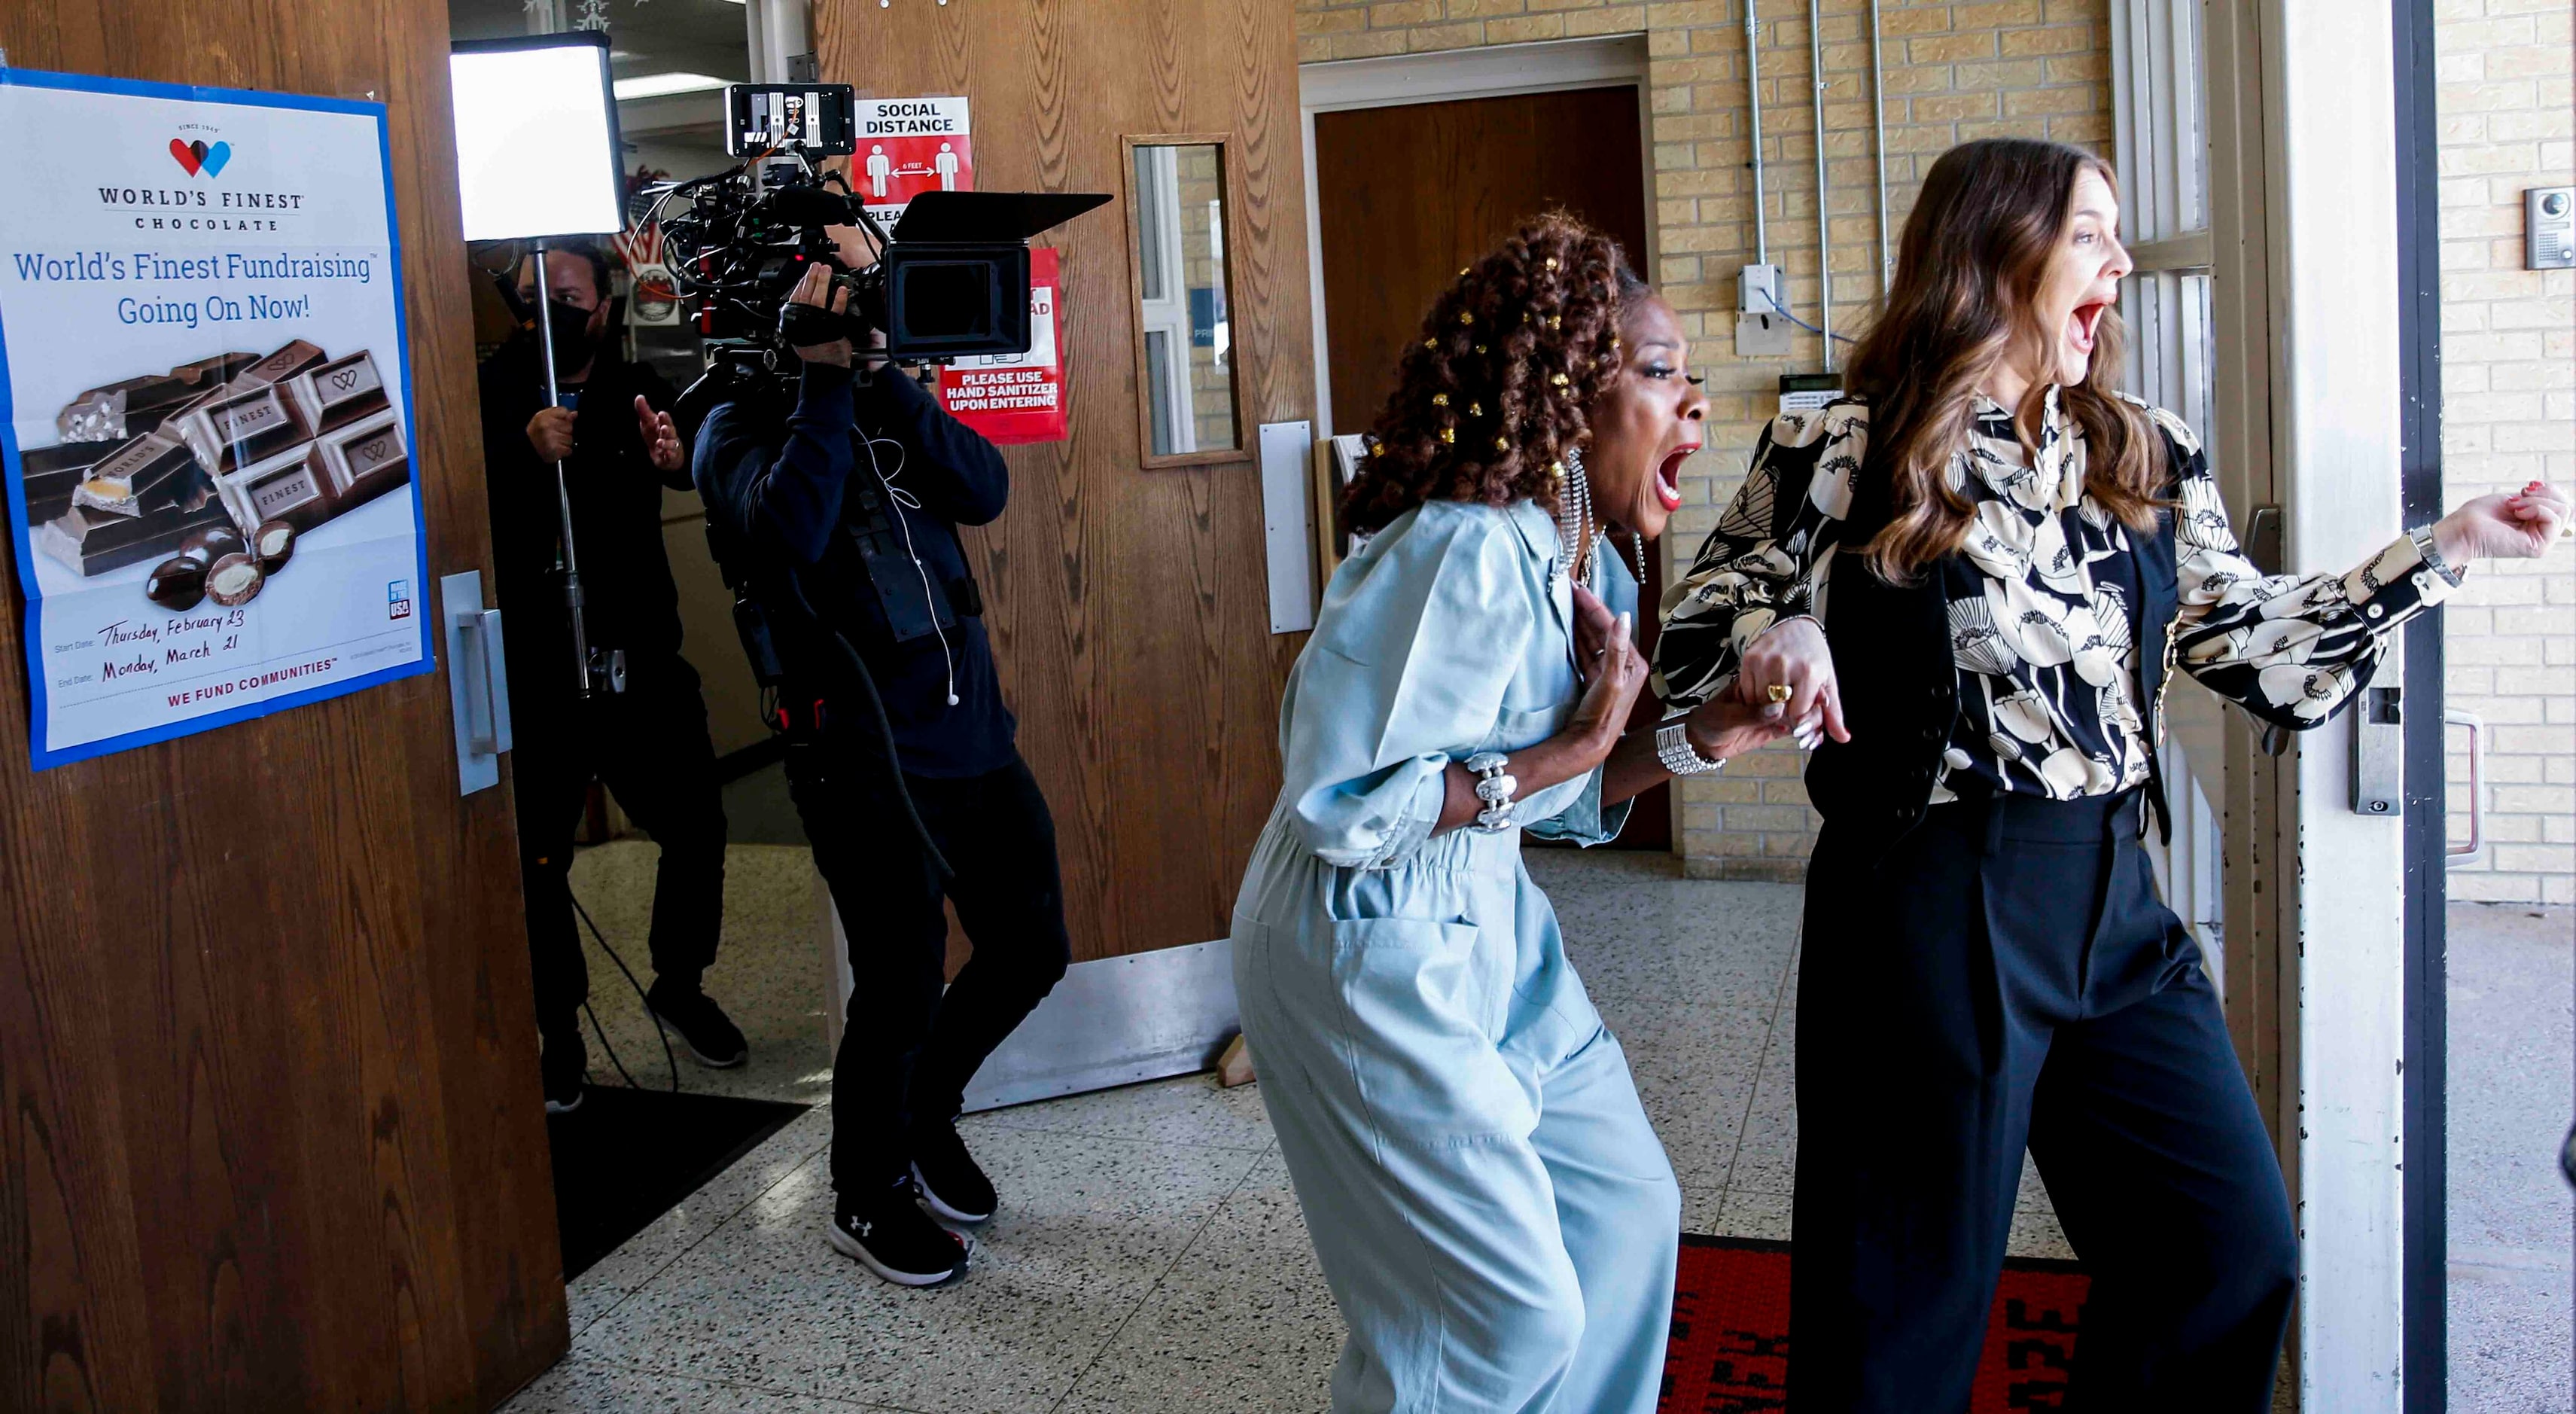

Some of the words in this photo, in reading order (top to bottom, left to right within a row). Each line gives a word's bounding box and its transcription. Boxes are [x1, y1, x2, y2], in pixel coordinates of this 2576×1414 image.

[877, 103, 941, 117] SOCIAL
[866, 118, 954, 134] DISTANCE
[99, 187, 207, 207] WORLD'S
[135, 217, 278, 232] CHOCOLATE
[14, 251, 126, 282] World's
[133, 252, 219, 281] Finest
[118, 296, 199, 329] Going
[206, 295, 242, 321] On
[249, 294, 310, 320] Now!
[961, 373, 1015, 386] PLEASE
[1016, 371, 1043, 382] USE
[946, 386, 985, 399] HAND
[987, 382, 1058, 398] SANITIZER
[950, 398, 988, 412] UPON
[990, 395, 1056, 410] ENTERING
[261, 480, 306, 506] FINEST
[390, 600, 410, 617] USA
[98, 620, 161, 647] Thursday,
[166, 615, 223, 636] February
[227, 609, 245, 627] 23
[54, 642, 74, 654] Start
[102, 654, 158, 683] Monday,
[166, 640, 211, 666] March
[223, 633, 238, 650] 21
[58, 678, 72, 688] End
[168, 692, 190, 707] WE
[196, 682, 234, 701] FUND
